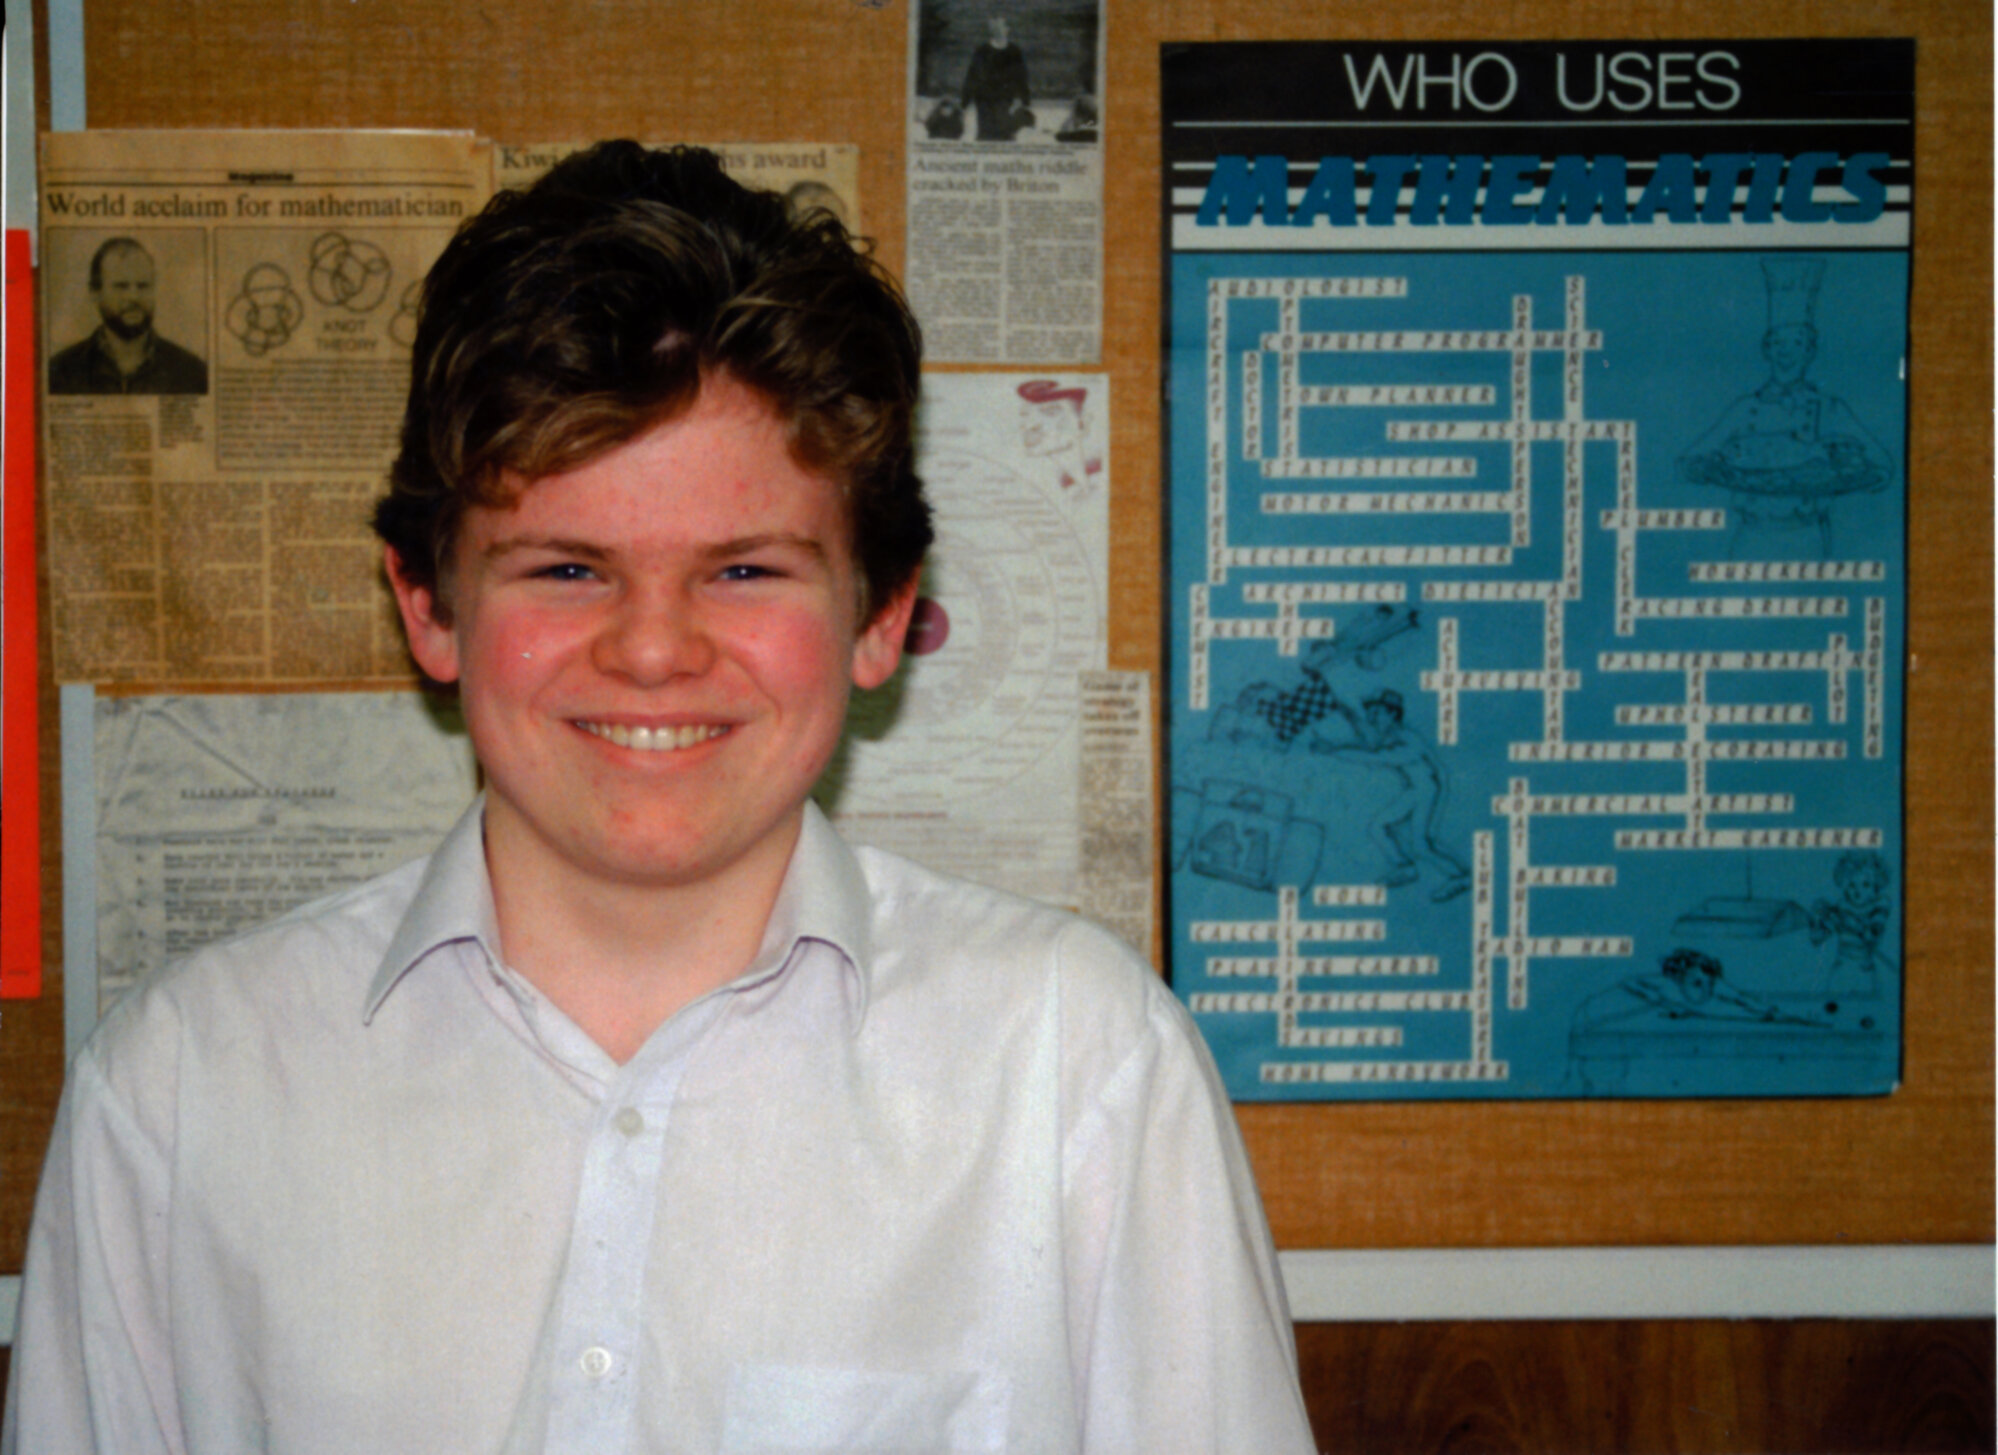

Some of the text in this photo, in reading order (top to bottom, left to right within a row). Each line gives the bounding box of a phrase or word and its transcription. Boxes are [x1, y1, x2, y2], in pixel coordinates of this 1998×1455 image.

[1343, 51, 1741, 111] WHO USES
[753, 148, 827, 169] award
[983, 158, 1034, 174] maths
[1038, 158, 1088, 175] riddle
[912, 177, 1060, 195] cracked by Briton
[1196, 152, 1890, 226] MATHEMATICS
[47, 193, 464, 218] World acclaim for mathematician
[1209, 278, 1403, 296] AUDIOLOGIST
[322, 319, 367, 333] KNOT
[316, 337, 378, 350] THEORY
[1263, 331, 1599, 349] COMPUTER PROGRAMMER
[1281, 278, 1296, 476] OPTOMETRIST
[1370, 387, 1491, 402] PLANNER
[1244, 353, 1259, 458] DOCTOR
[1513, 297, 1529, 544] DRAUGHTSPERSON
[1208, 279, 1224, 582] AIRCRAFT ENGINEER
[1389, 423, 1631, 440] SHOP ASSISTANT
[1566, 276, 1582, 597] SCIENCE TECHNICIAN
[1264, 460, 1473, 477] STATISTICIAN
[1264, 496, 1349, 512] MOTOR
[1602, 510, 1722, 528] PLUMBER
[1618, 424, 1635, 634] TRAVEL CLERK
[1213, 548, 1508, 566] ELECTRICAL FITTER
[1689, 562, 1882, 580] HOUSEKEEPER
[1246, 584, 1403, 600] ARCHITECT
[1423, 582, 1578, 599] DIETICIAN
[1620, 599, 1845, 617] RACING DRIVER
[1602, 654, 1721, 669] PATTERN
[1423, 672, 1577, 690] SURVEYING
[1832, 635, 1845, 722] PILOT
[1619, 706, 1811, 724] UPHOLSTERER
[1513, 743, 1846, 759] INTERIOR DECORATING
[1493, 795, 1790, 813] COMMERCIAL ARTIST
[1619, 829, 1880, 847] MARKET GARDENER
[1318, 887, 1383, 905] GOLF
[1194, 923, 1382, 940] CALCULATING
[1581, 939, 1631, 955] HAM
[1212, 956, 1436, 975] PLAYING CARDS
[1263, 1064, 1326, 1081] HOME
